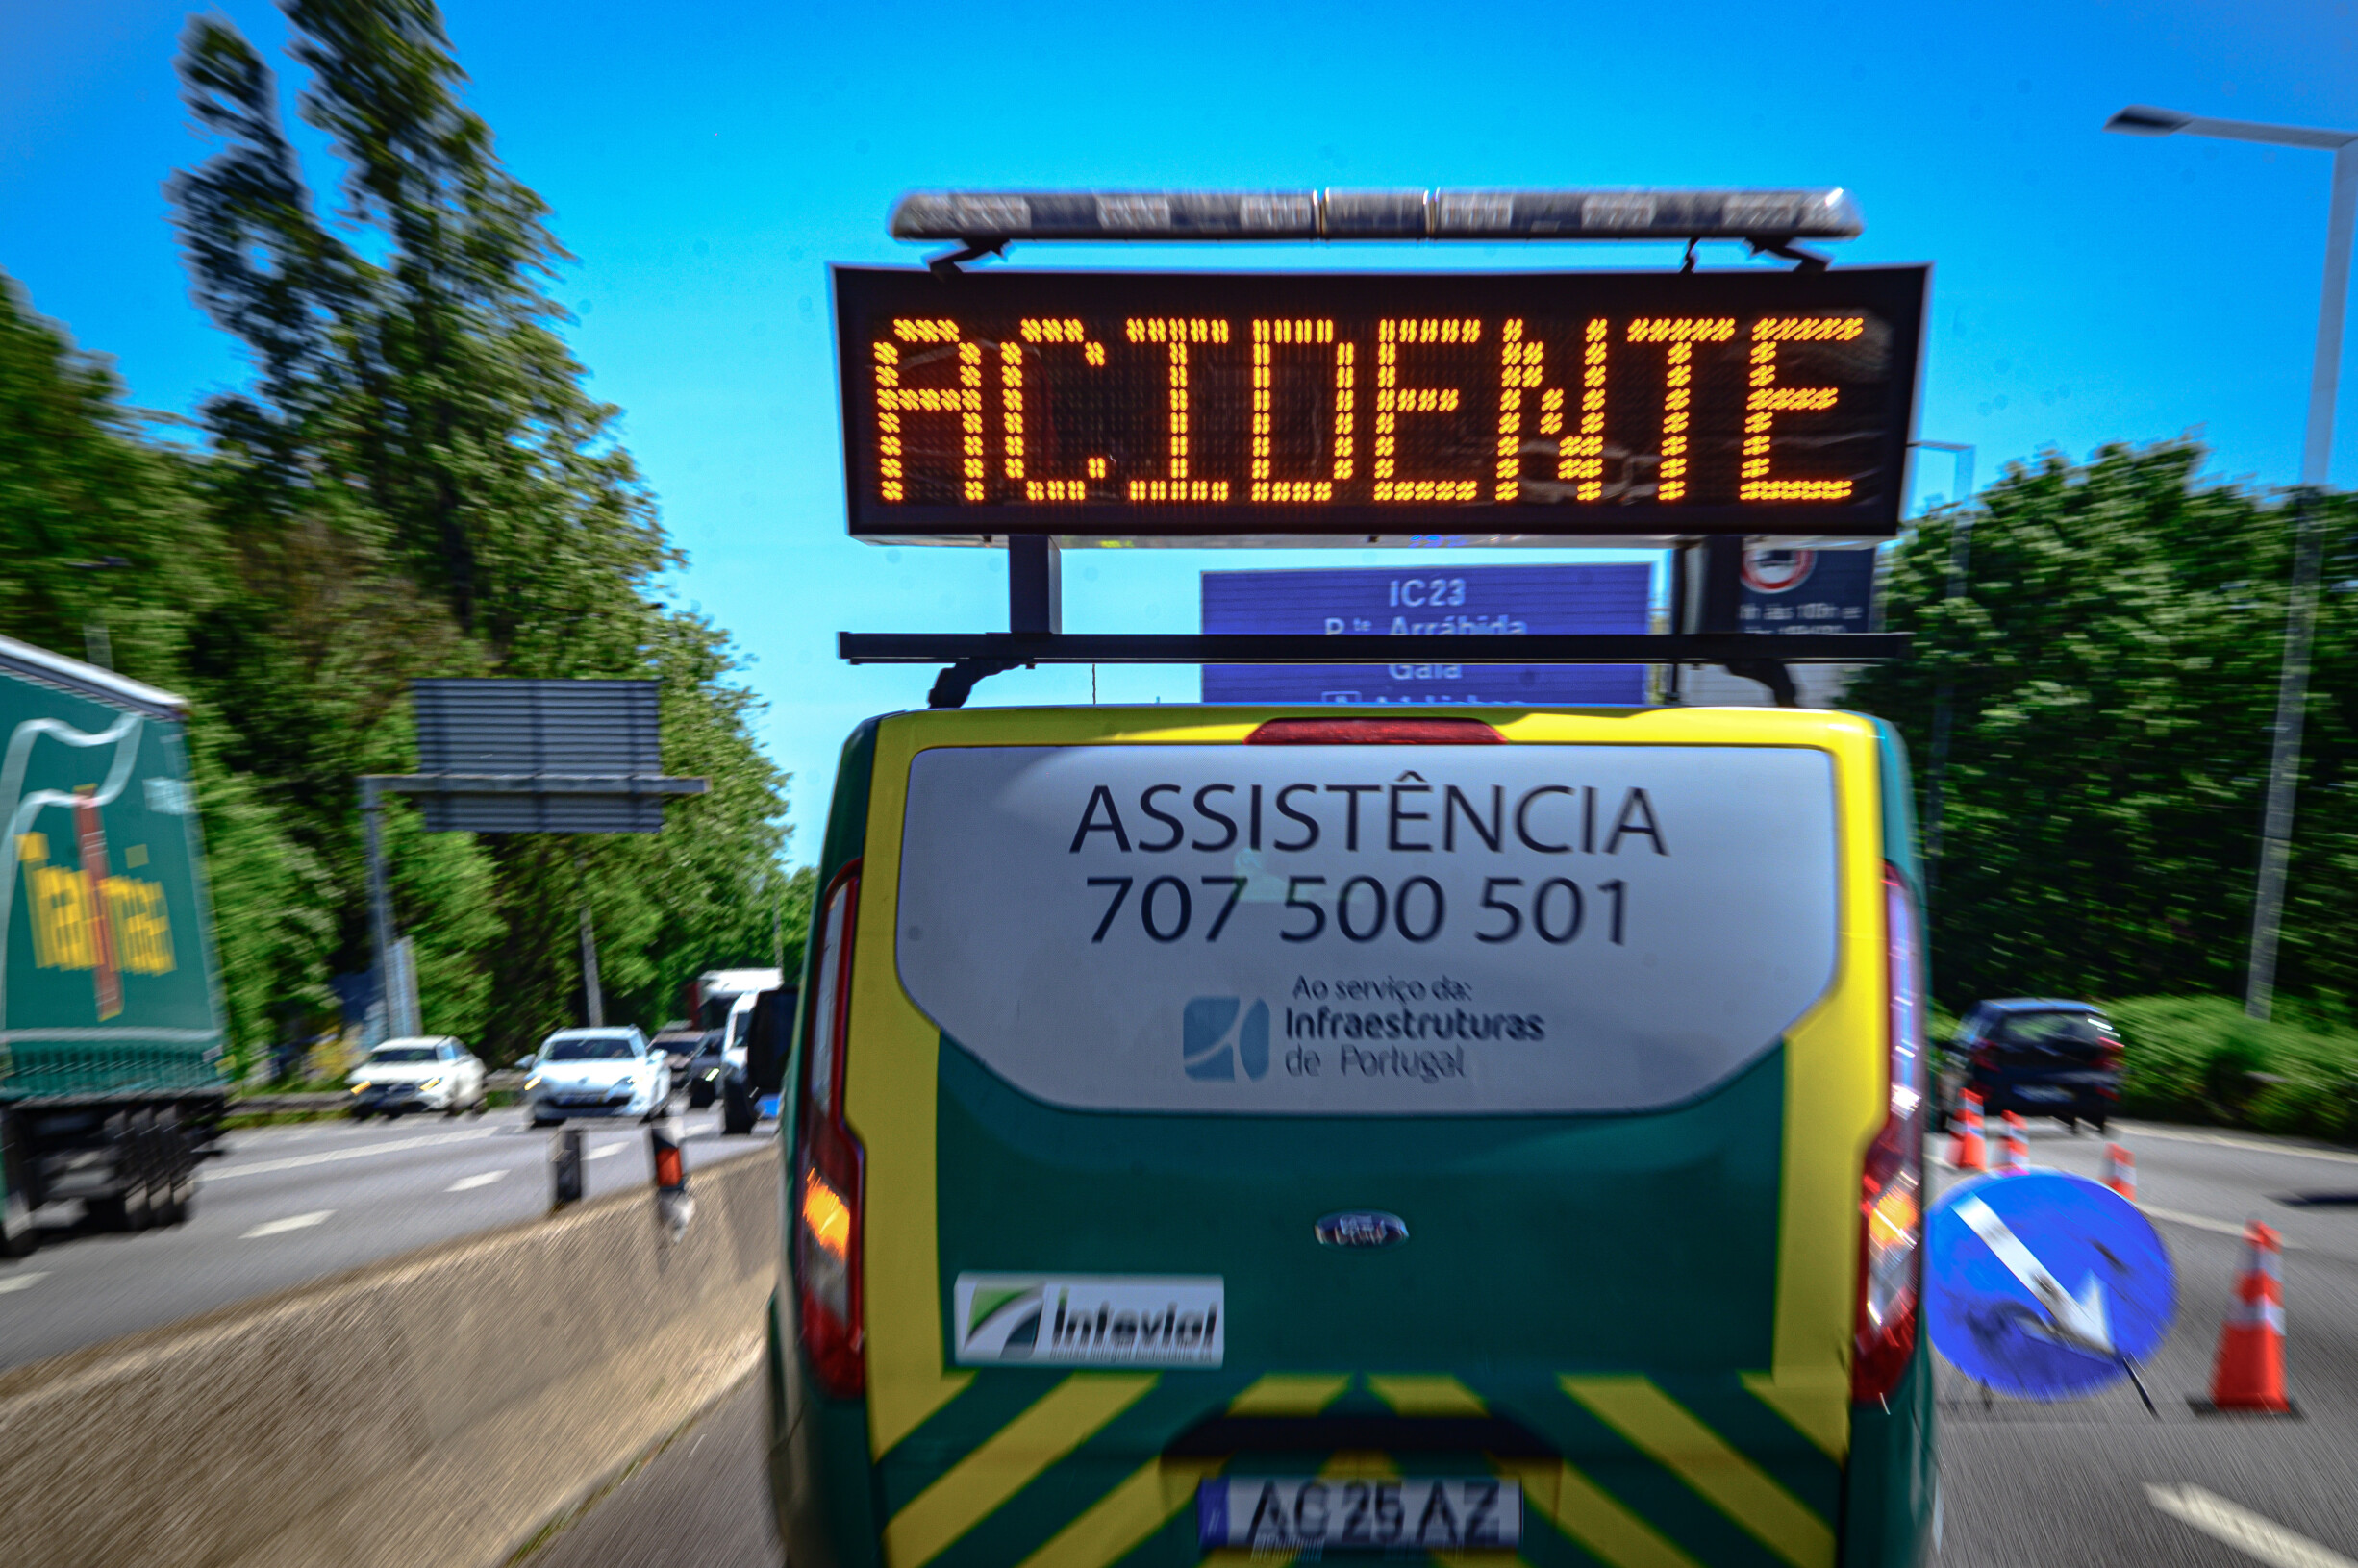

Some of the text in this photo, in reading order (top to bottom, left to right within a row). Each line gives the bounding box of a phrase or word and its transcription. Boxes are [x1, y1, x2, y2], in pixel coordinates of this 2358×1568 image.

[874, 318, 1864, 502] ACIDENTE
[1389, 578, 1466, 607] IC23
[1068, 770, 1670, 857] ASSISTÊNCIA
[1087, 875, 1627, 946] 707 500 501
[1292, 974, 1329, 1001] Ao
[1335, 975, 1427, 1007] serviço
[1285, 1006, 1545, 1041] Infraestruturas
[1285, 1043, 1466, 1084] de Portugal
